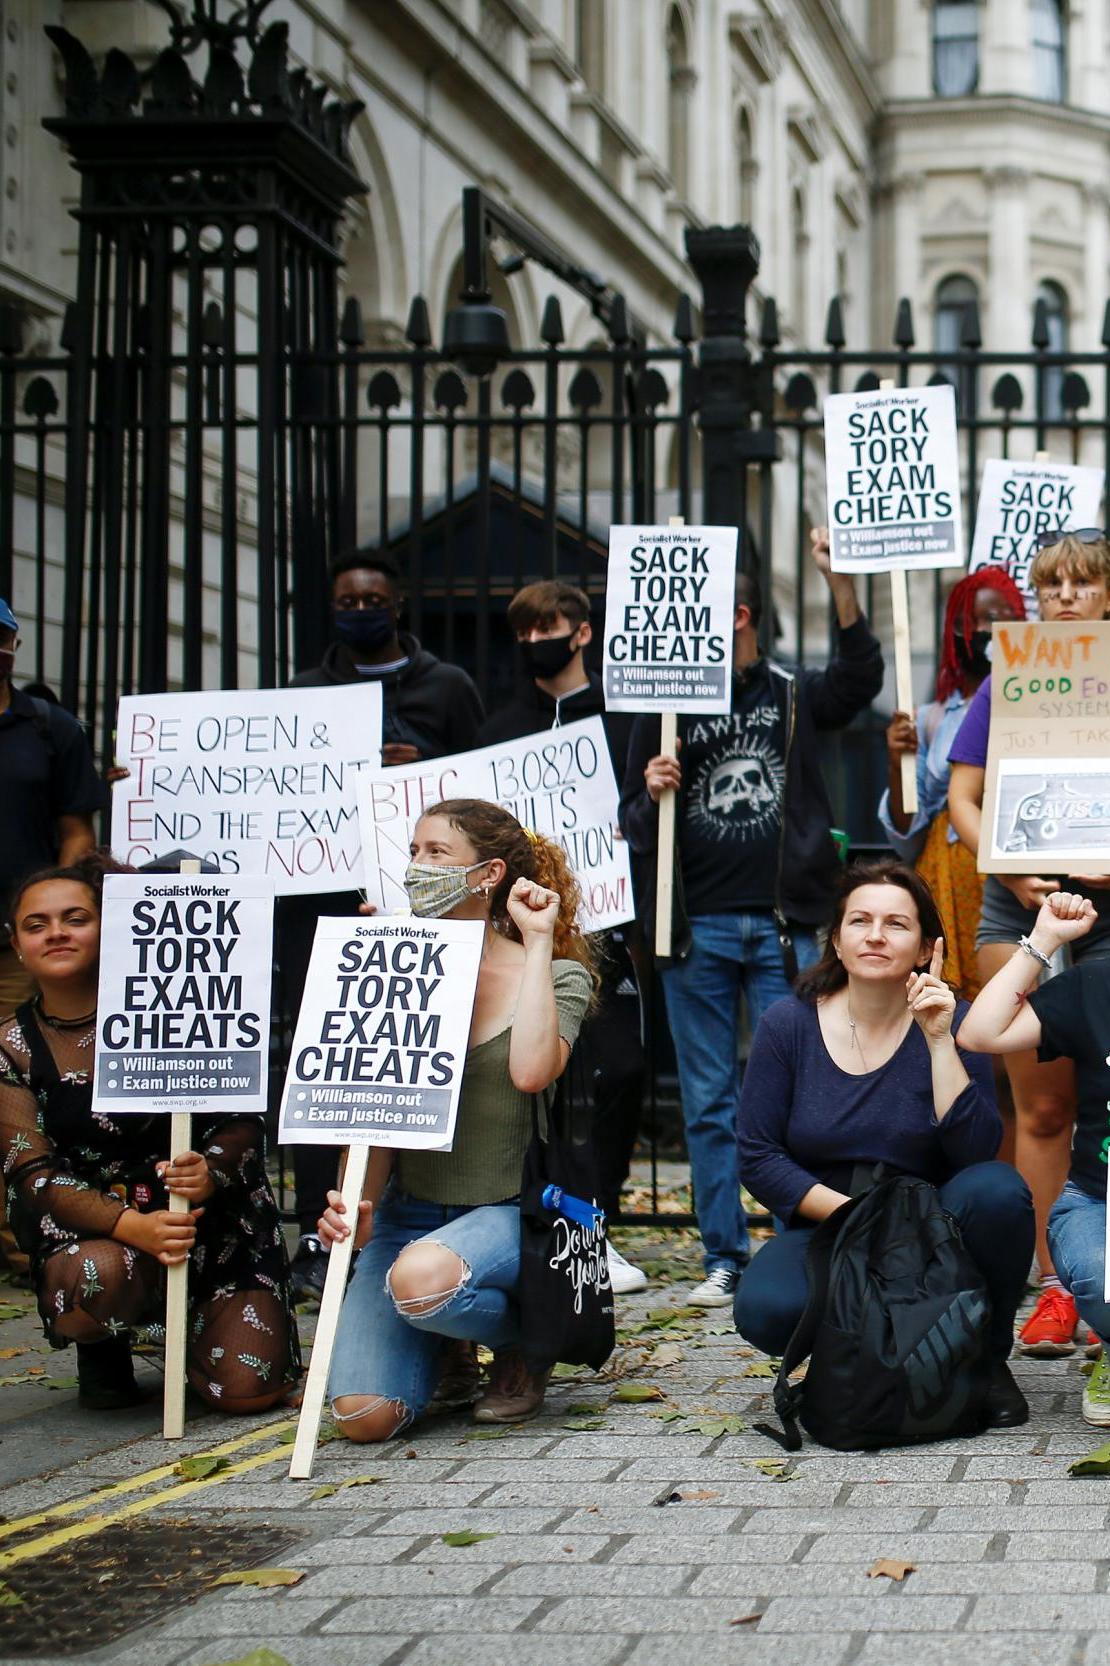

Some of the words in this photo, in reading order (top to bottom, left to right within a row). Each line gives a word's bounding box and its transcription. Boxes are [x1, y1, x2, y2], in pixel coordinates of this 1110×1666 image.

[849, 407, 929, 438] SACK
[851, 436, 928, 466] TORY
[848, 464, 935, 496] EXAM
[834, 491, 952, 525] CHEATS
[1001, 480, 1076, 511] SACK
[849, 527, 913, 543] Williamson
[916, 525, 934, 537] out
[1000, 508, 1070, 536] TORY
[630, 547, 709, 573] SACK
[851, 541, 882, 555] Exam
[883, 540, 923, 555] justice
[924, 539, 949, 550] now
[631, 576, 707, 603] TORY
[624, 606, 711, 632] EXAM
[609, 635, 725, 662] CHEATS
[998, 625, 1098, 670] WANT
[623, 669, 684, 681] Williamson
[685, 670, 704, 681] out
[1003, 676, 1072, 702] GOOD
[623, 684, 652, 695] Exam
[654, 684, 692, 696] justice
[695, 685, 718, 695] now
[130, 713, 182, 753] BE
[196, 714, 298, 752] OPEN
[310, 721, 332, 749] &
[1003, 731, 1050, 750] JUST
[127, 799, 202, 841] END
[212, 810, 263, 840] THE
[277, 804, 359, 840] EXAM
[265, 837, 363, 878] NOW
[144, 885, 190, 897] Socialist
[190, 885, 230, 897] Worker
[131, 900, 241, 936] SACK
[355, 926, 399, 937] Socialist
[400, 927, 439, 939] Worker
[132, 938, 238, 973] TORY
[337, 940, 449, 976] SACK
[124, 975, 242, 1011] EXAM
[336, 975, 441, 1011] TORY
[102, 1012, 261, 1050] CHEATS
[319, 1011, 441, 1048] EXAM
[122, 1057, 205, 1071] Williamson
[209, 1056, 233, 1070] out
[295, 1046, 455, 1086] CHEATS
[122, 1076, 163, 1090] Exam
[165, 1076, 217, 1092] justice
[220, 1076, 250, 1088] now
[311, 1089, 396, 1105] Williamson
[396, 1091, 423, 1106] out
[307, 1107, 348, 1122] Exam
[350, 1109, 403, 1124] justice
[406, 1112, 438, 1126] now
